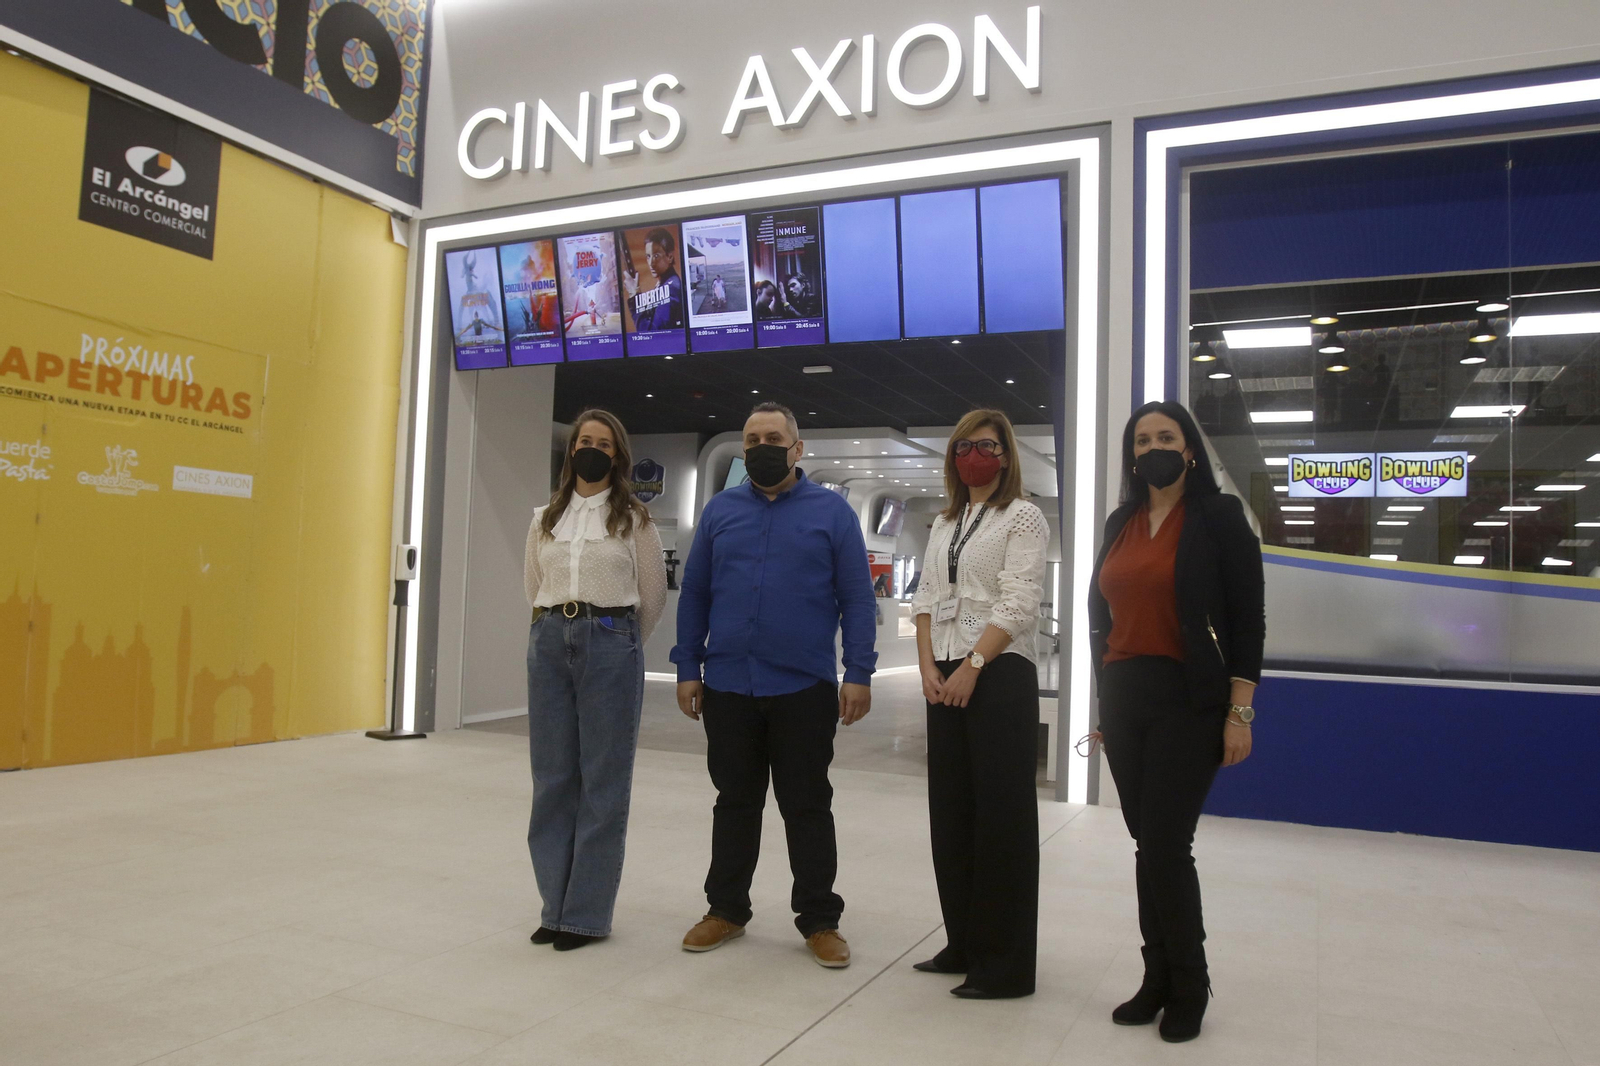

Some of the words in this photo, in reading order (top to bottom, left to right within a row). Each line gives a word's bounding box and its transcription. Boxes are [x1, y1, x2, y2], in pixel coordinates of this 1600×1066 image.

[457, 73, 683, 180] CINES
[721, 5, 1041, 138] AXION
[92, 166, 111, 189] El
[117, 177, 210, 222] Arcángel
[90, 191, 141, 217] CENTRO
[143, 208, 208, 239] COMERCIAL
[775, 225, 807, 236] INMUNE
[576, 250, 594, 261] TOM
[576, 258, 599, 269] JERRY
[504, 282, 528, 293] GODZILLA
[531, 279, 556, 290] KONG
[635, 284, 671, 309] LIBERTAD
[79, 332, 195, 386] PRÓXIMAS
[0, 345, 252, 420] APERTURAS
[0, 386, 54, 402] COMIENZA
[58, 396, 79, 406] UNA
[82, 401, 114, 413] NUEVA
[117, 406, 147, 418] ETAPA
[150, 412, 162, 420] EN
[164, 414, 175, 422] TU
[177, 416, 189, 425] CC
[191, 419, 200, 427] EL
[202, 421, 244, 434] ARCÁNGEL
[1292, 457, 1373, 482] BOWLING
[1380, 456, 1465, 482] BOWLING
[214, 475, 250, 489] AXION
[1313, 476, 1351, 489] CLUB
[1402, 476, 1441, 489] CLUB
